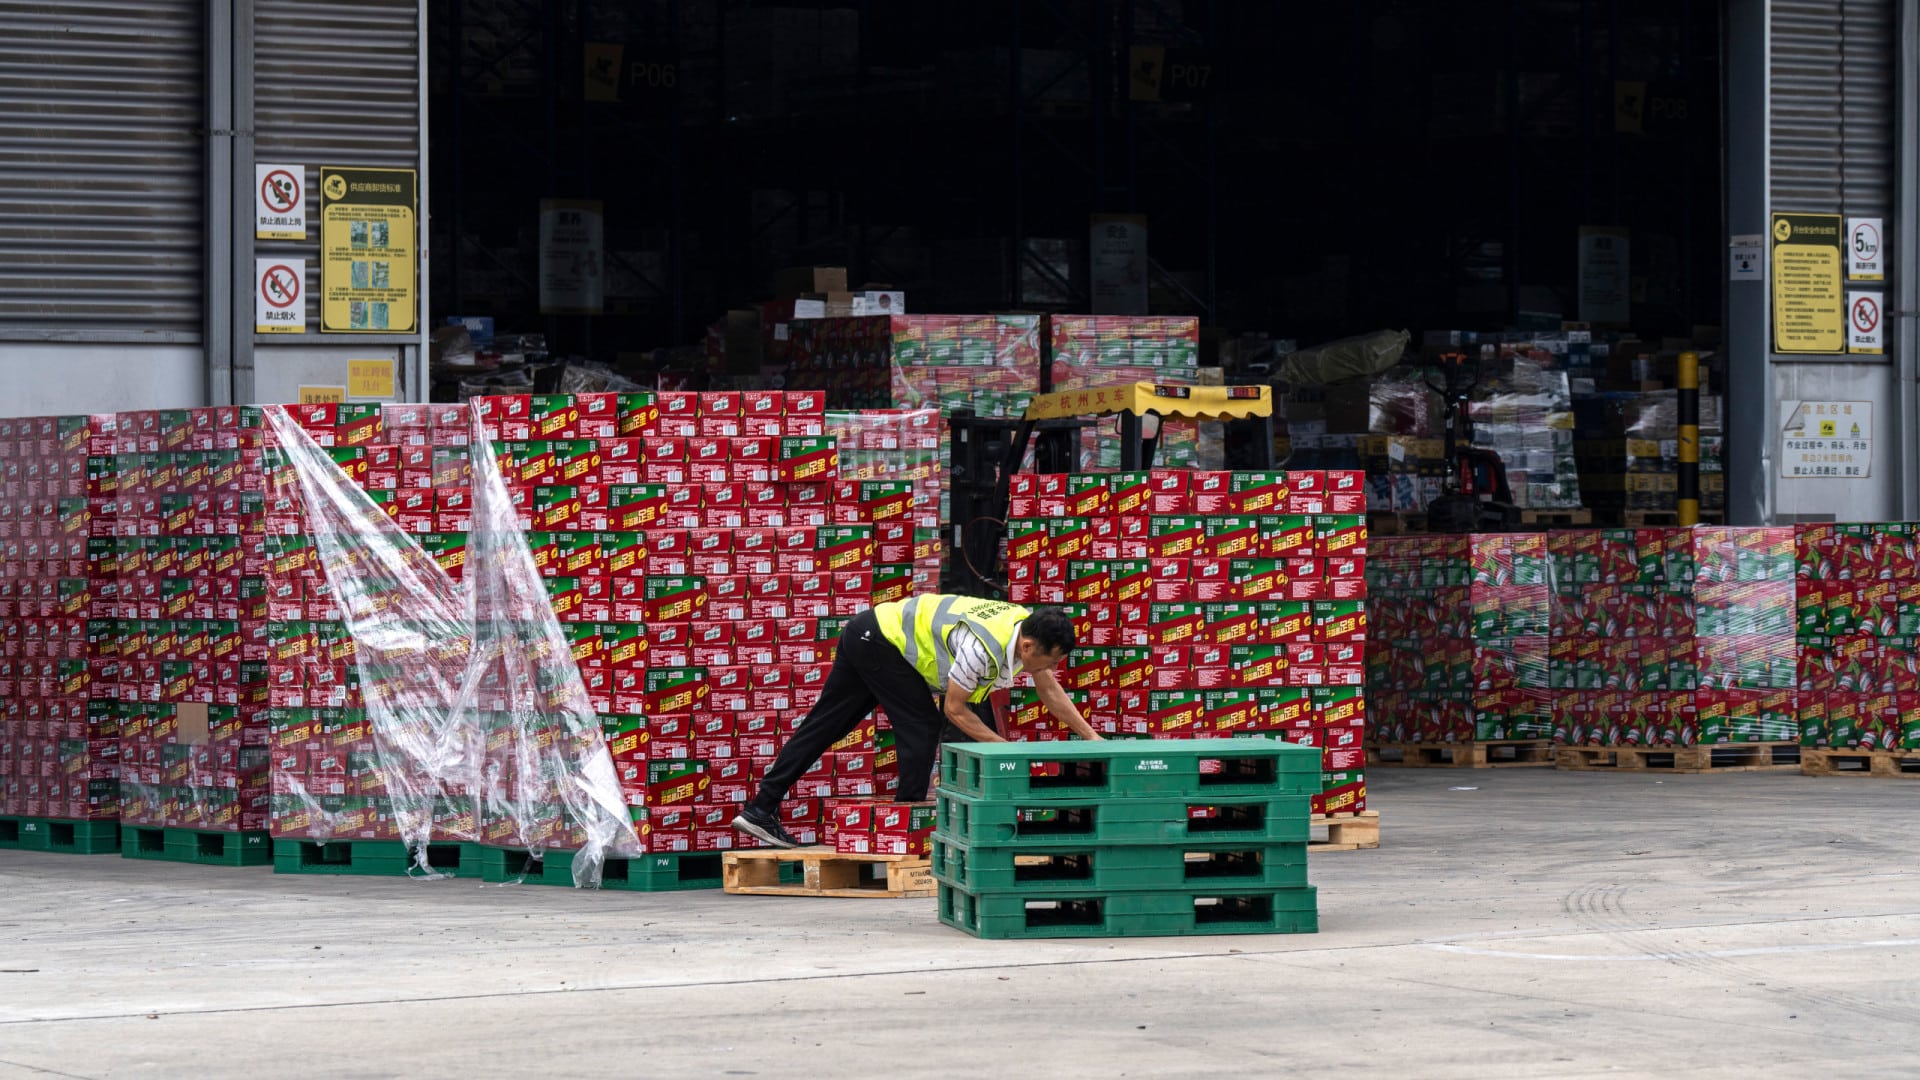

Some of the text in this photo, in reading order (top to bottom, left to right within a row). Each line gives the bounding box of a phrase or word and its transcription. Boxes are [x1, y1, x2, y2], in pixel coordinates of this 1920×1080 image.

[630, 63, 676, 88] P06
[1170, 64, 1213, 88] P07
[260, 216, 302, 226] 禁止酒后上岗
[265, 311, 296, 321] 禁止烟火
[1060, 388, 1125, 409] 杭州叉车
[999, 762, 1016, 771] PW
[248, 837, 261, 845] PW
[657, 858, 669, 867] PW
